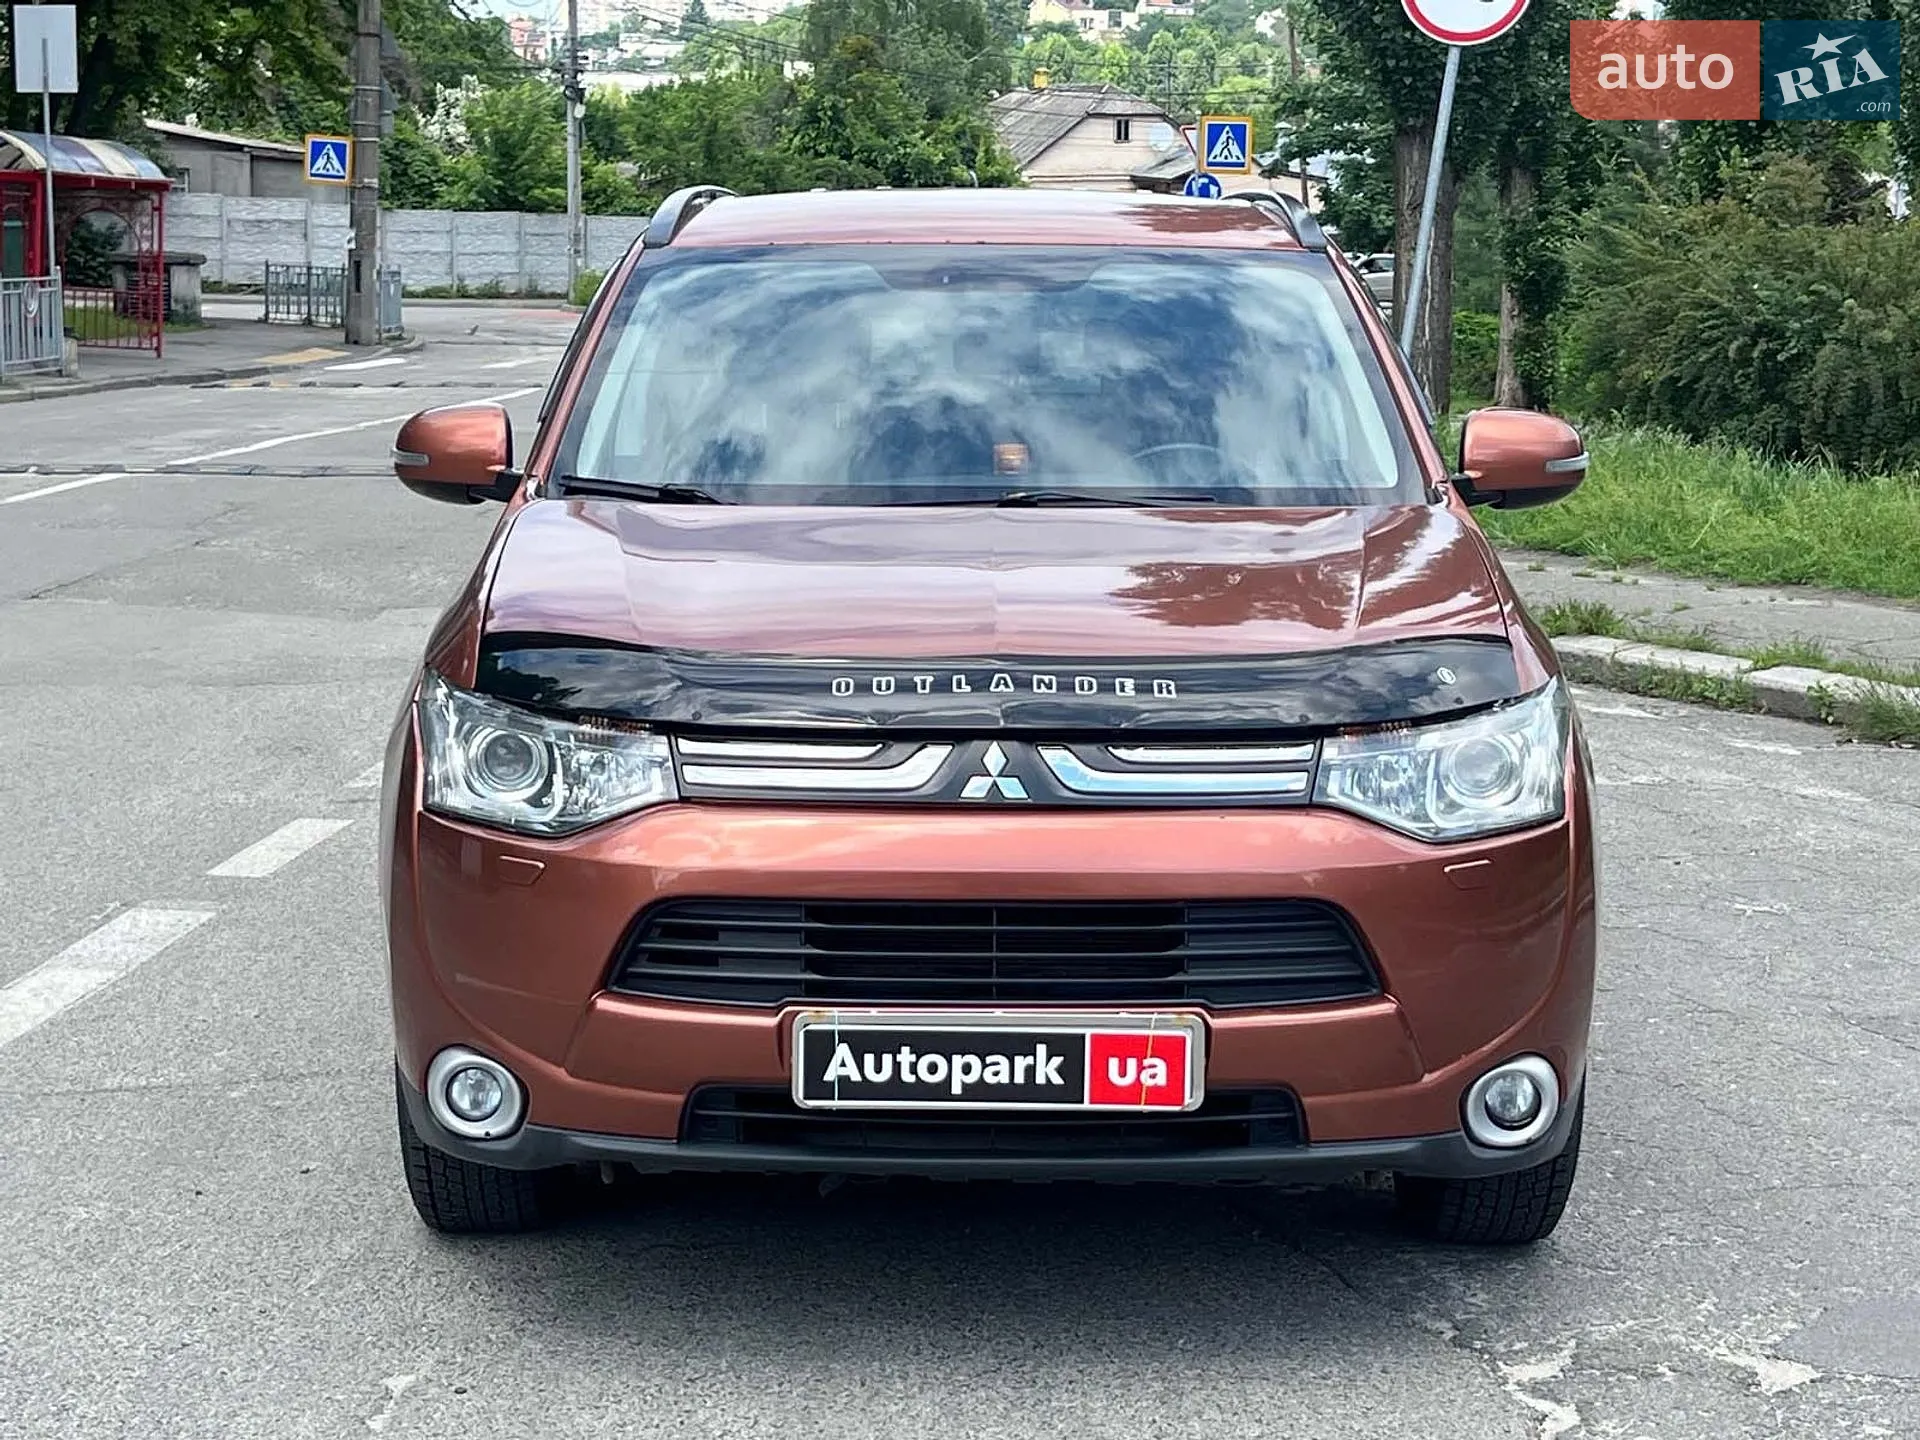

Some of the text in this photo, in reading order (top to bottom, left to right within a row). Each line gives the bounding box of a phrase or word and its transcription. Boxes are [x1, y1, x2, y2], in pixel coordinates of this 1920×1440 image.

[831, 672, 1177, 699] OUTLANDER
[823, 1041, 1169, 1095] Autopark ua
